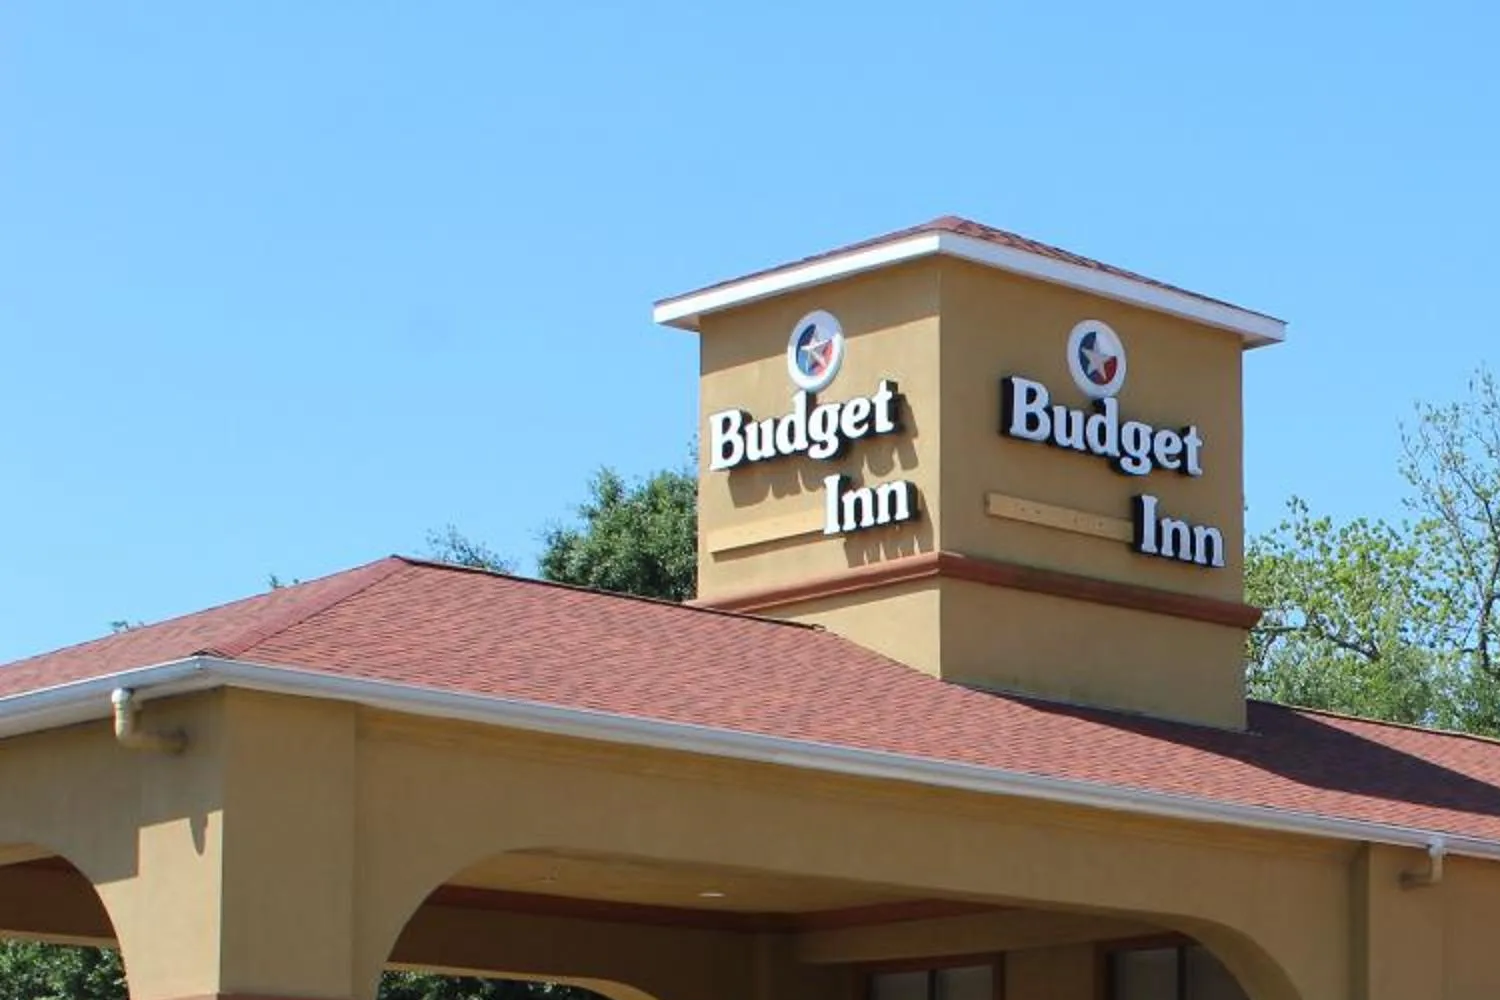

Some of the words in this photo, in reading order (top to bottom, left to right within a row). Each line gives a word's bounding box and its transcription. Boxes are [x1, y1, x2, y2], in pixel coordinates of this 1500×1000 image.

[709, 380, 896, 472] Budget
[1008, 375, 1204, 477] Budget
[823, 475, 911, 535] Inn
[1138, 494, 1225, 568] Inn
